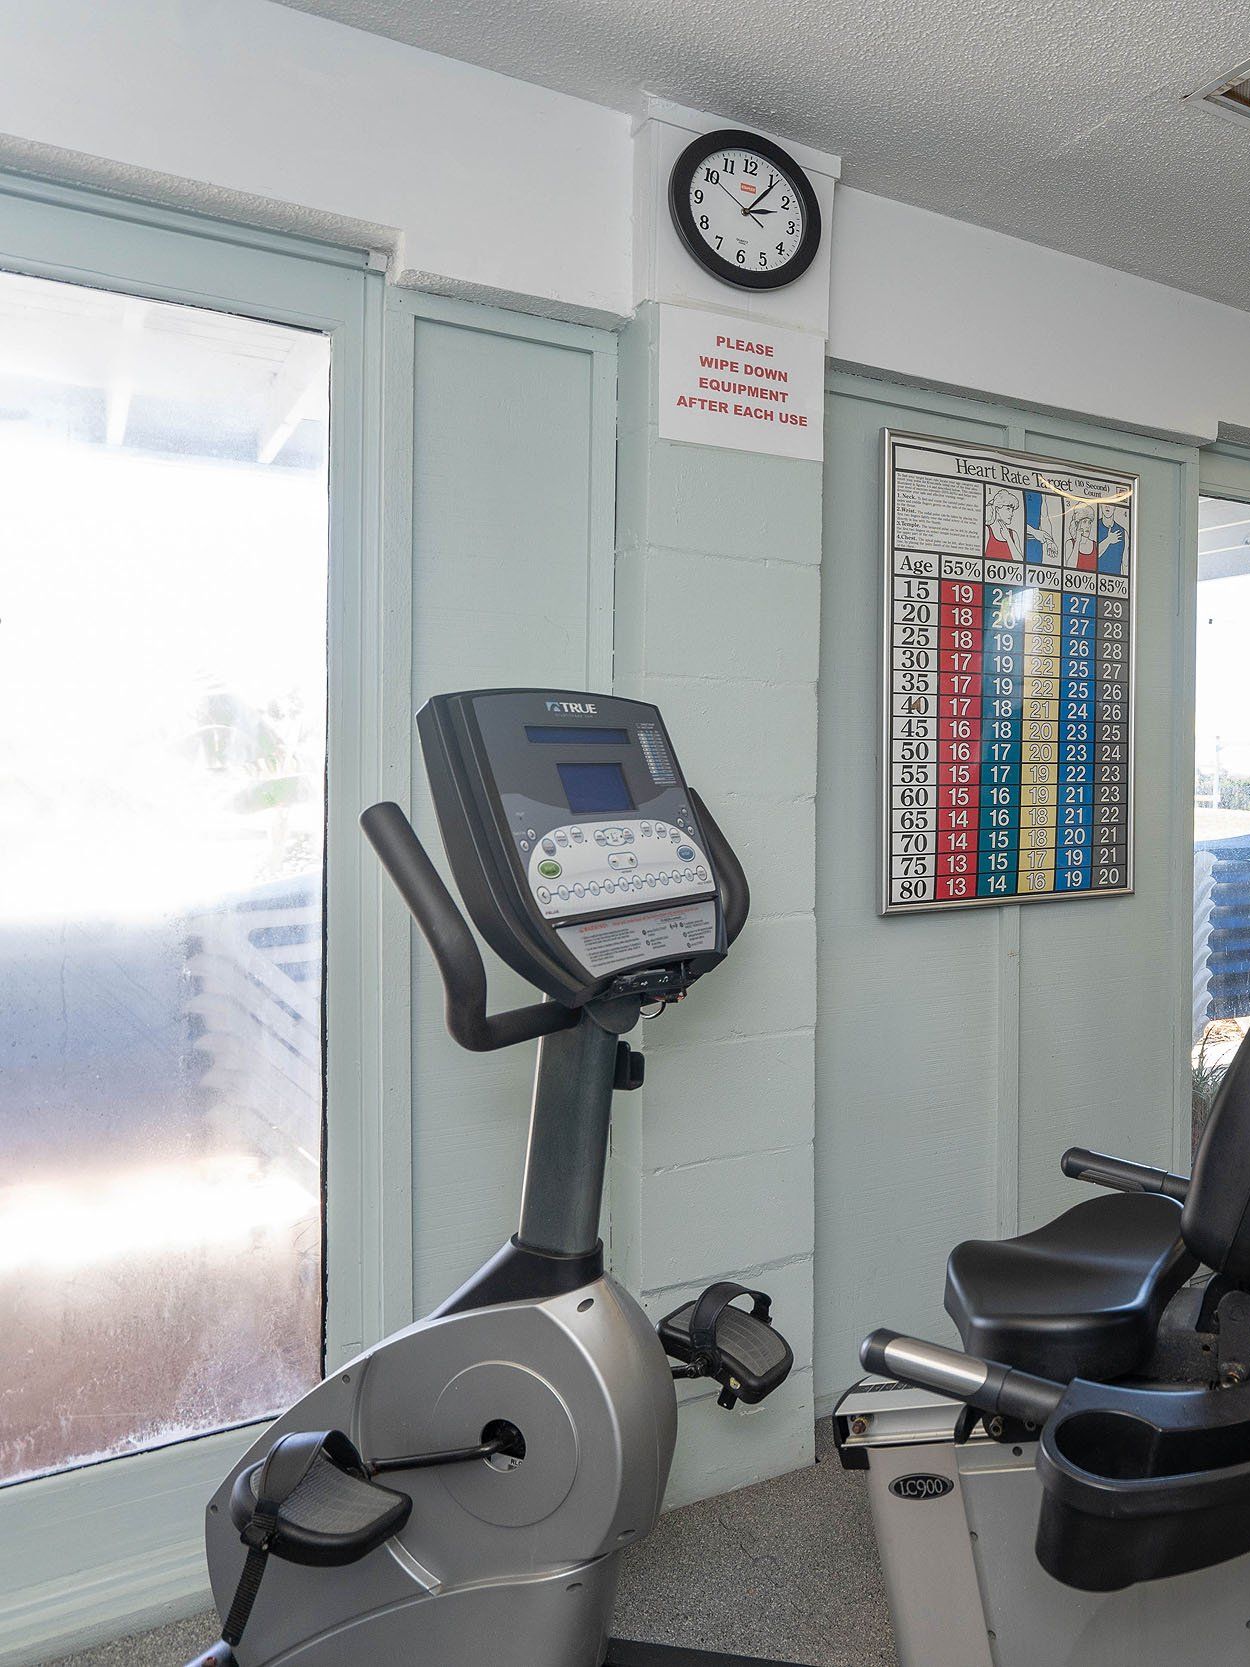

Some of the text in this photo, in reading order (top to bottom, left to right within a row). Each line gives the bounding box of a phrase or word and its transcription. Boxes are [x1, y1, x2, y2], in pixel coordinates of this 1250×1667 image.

[704, 168, 720, 185] 10
[722, 158, 735, 175] 11
[743, 159, 758, 176] 12
[768, 174, 774, 188] 1
[694, 189, 704, 204] 9
[781, 196, 790, 210] 2
[699, 215, 710, 230] 8
[786, 221, 795, 235] 3
[714, 235, 724, 250] 7
[775, 242, 785, 256] 4
[736, 250, 746, 264] 6
[758, 252, 768, 267] 5
[716, 335, 774, 358] PLEASE
[699, 356, 788, 382] WIPE DOWN
[698, 377, 788, 403] EQUIPMENT
[676, 395, 808, 427] AFTER EACH USE
[955, 458, 1074, 493] Heart Rate Target
[1086, 481, 1110, 493] Second)
[900, 555, 1127, 595] Age 55% 60% 70% 80% 85%
[904, 580, 1122, 618] 15 19 21 24 27 29
[902, 604, 930, 623] 20
[952, 608, 973, 625] 18
[1032, 615, 1054, 633] 23
[1070, 619, 1089, 635] 27
[1104, 623, 1122, 639] 28
[902, 628, 1122, 659] 25 18 19 23 26 28
[902, 651, 1122, 679] 30 17 19 22 25 27
[902, 673, 1121, 700] 35 17 19 22 25 26
[560, 702, 598, 714] TRUE
[901, 696, 1121, 720] 40 17 18 21 24 26
[901, 719, 1120, 740] 45 16 18 20 23 25
[901, 742, 1120, 761] 50 16 17 20 23 24
[901, 765, 1120, 783] 55 15 17 19 22 23
[900, 786, 1119, 806] 60 15 16 19 21 23
[900, 808, 1119, 829] 65 14 16 18 21 22
[900, 827, 1117, 852] 70 14 15 18 20 21
[900, 848, 1116, 875] 75 13 15 17 19 21
[900, 868, 1119, 898] 80 13 14 16 19 20
[900, 1479, 943, 1498] LC900
